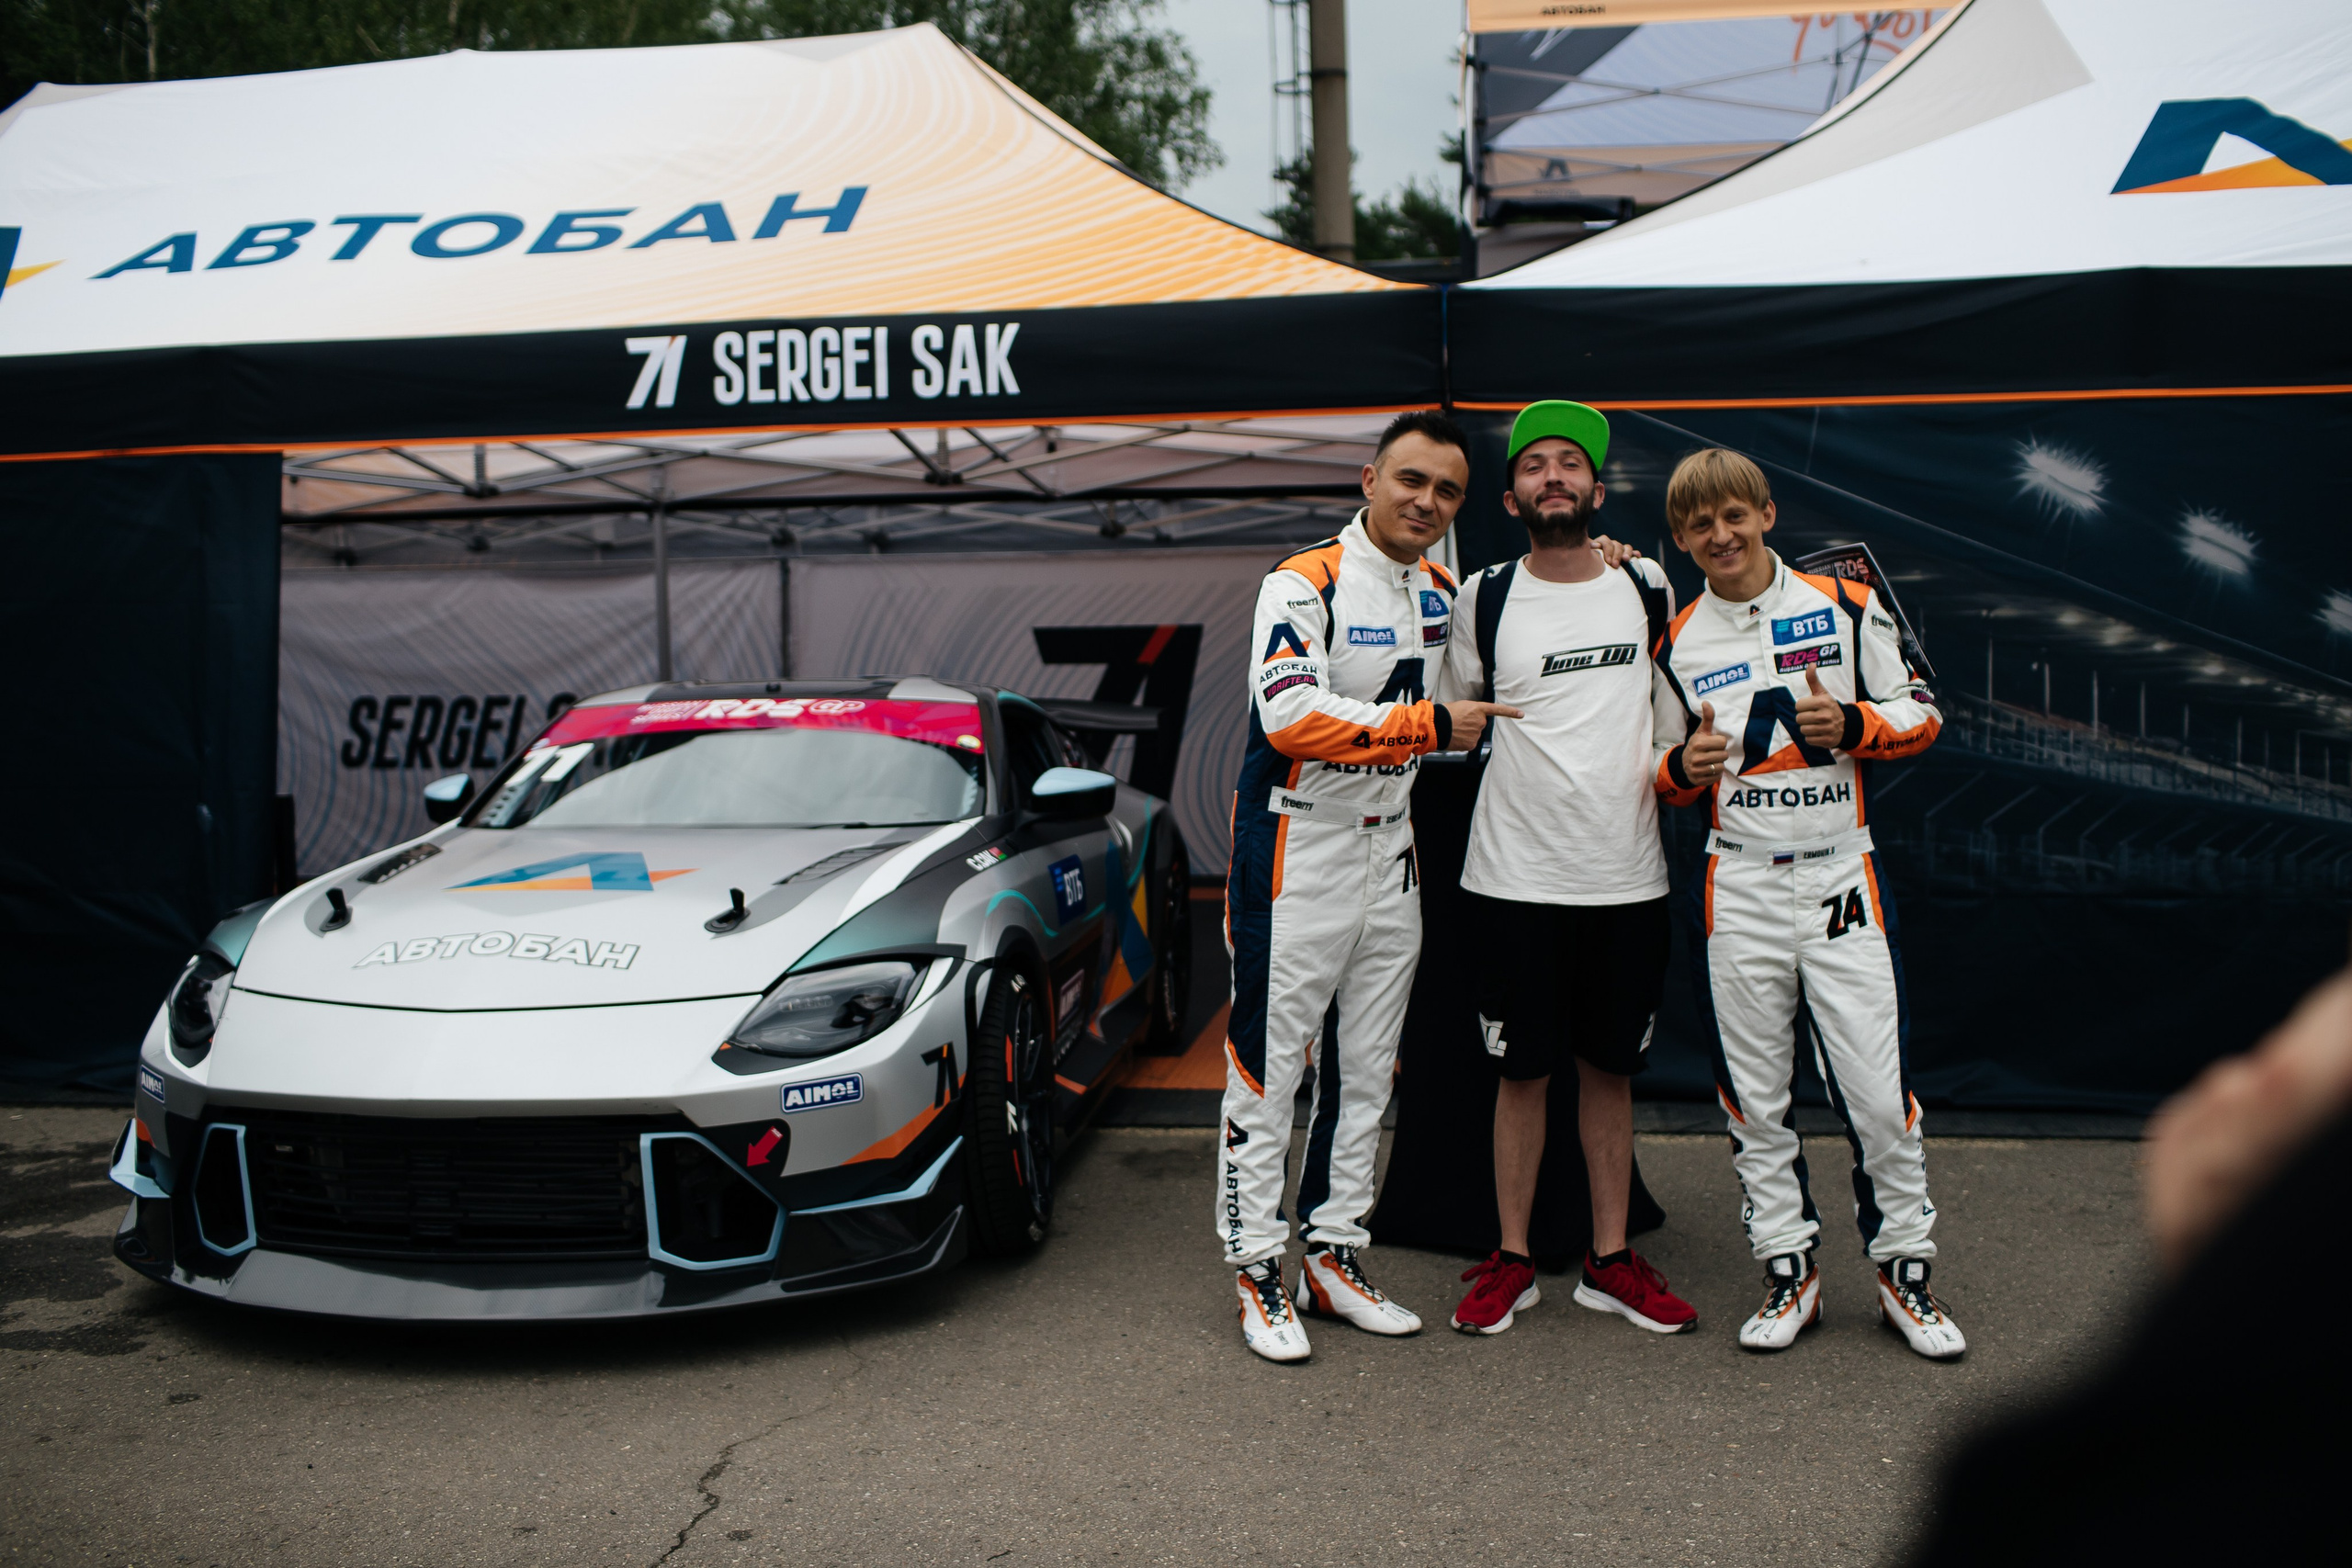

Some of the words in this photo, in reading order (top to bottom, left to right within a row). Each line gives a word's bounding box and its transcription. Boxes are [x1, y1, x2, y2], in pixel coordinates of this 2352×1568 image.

[88, 186, 868, 279] АВТОБАН
[713, 326, 888, 405] SERGEI
[911, 322, 1021, 399] SAK
[1351, 629, 1395, 643] AIMOL
[1792, 615, 1828, 637] ВТБ
[1781, 647, 1820, 668] RDS
[1820, 644, 1838, 657] GP
[1260, 663, 1317, 685] АВТОБАН
[1266, 675, 1316, 698] VDRIFTE.RU
[1697, 666, 1747, 694] AIMOL
[341, 694, 527, 769] SERGEI
[1725, 782, 1850, 808] АВТОБАН
[1064, 868, 1084, 906] ВТБ
[352, 931, 641, 970] АВТОБАН
[786, 1080, 858, 1107] AIMOL
[1227, 1160, 1244, 1254] АВТОБАН
